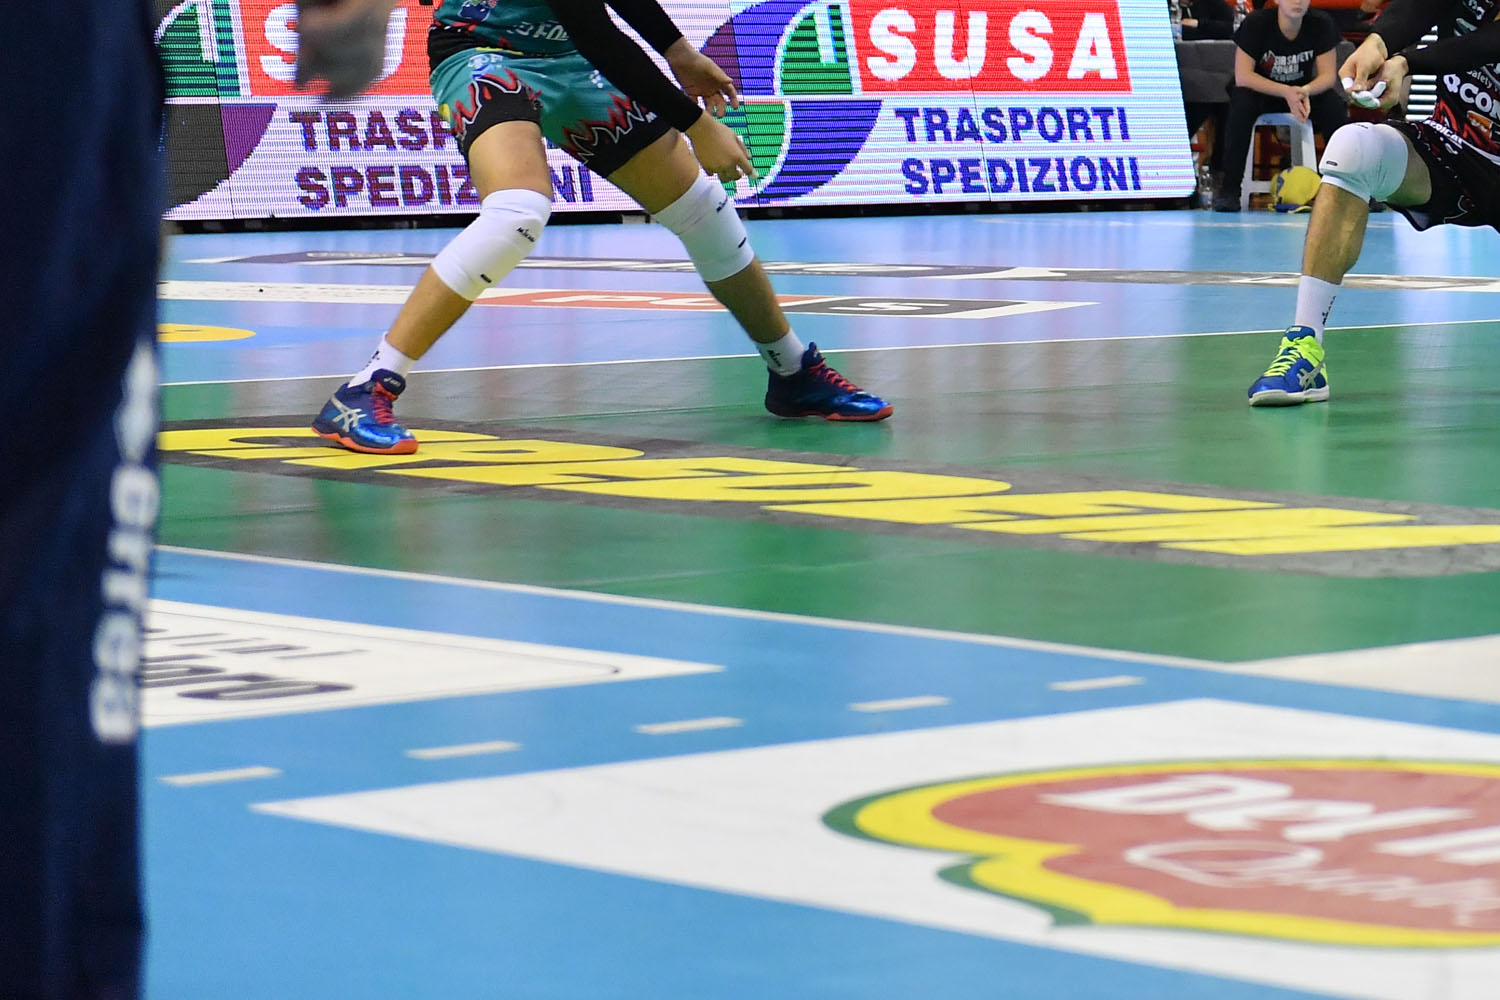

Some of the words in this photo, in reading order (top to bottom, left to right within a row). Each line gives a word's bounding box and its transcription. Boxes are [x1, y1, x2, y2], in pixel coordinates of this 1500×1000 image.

[867, 7, 1119, 81] SUSA
[894, 106, 1131, 143] TRASPORTI
[901, 155, 1142, 195] SPEDIZIONI
